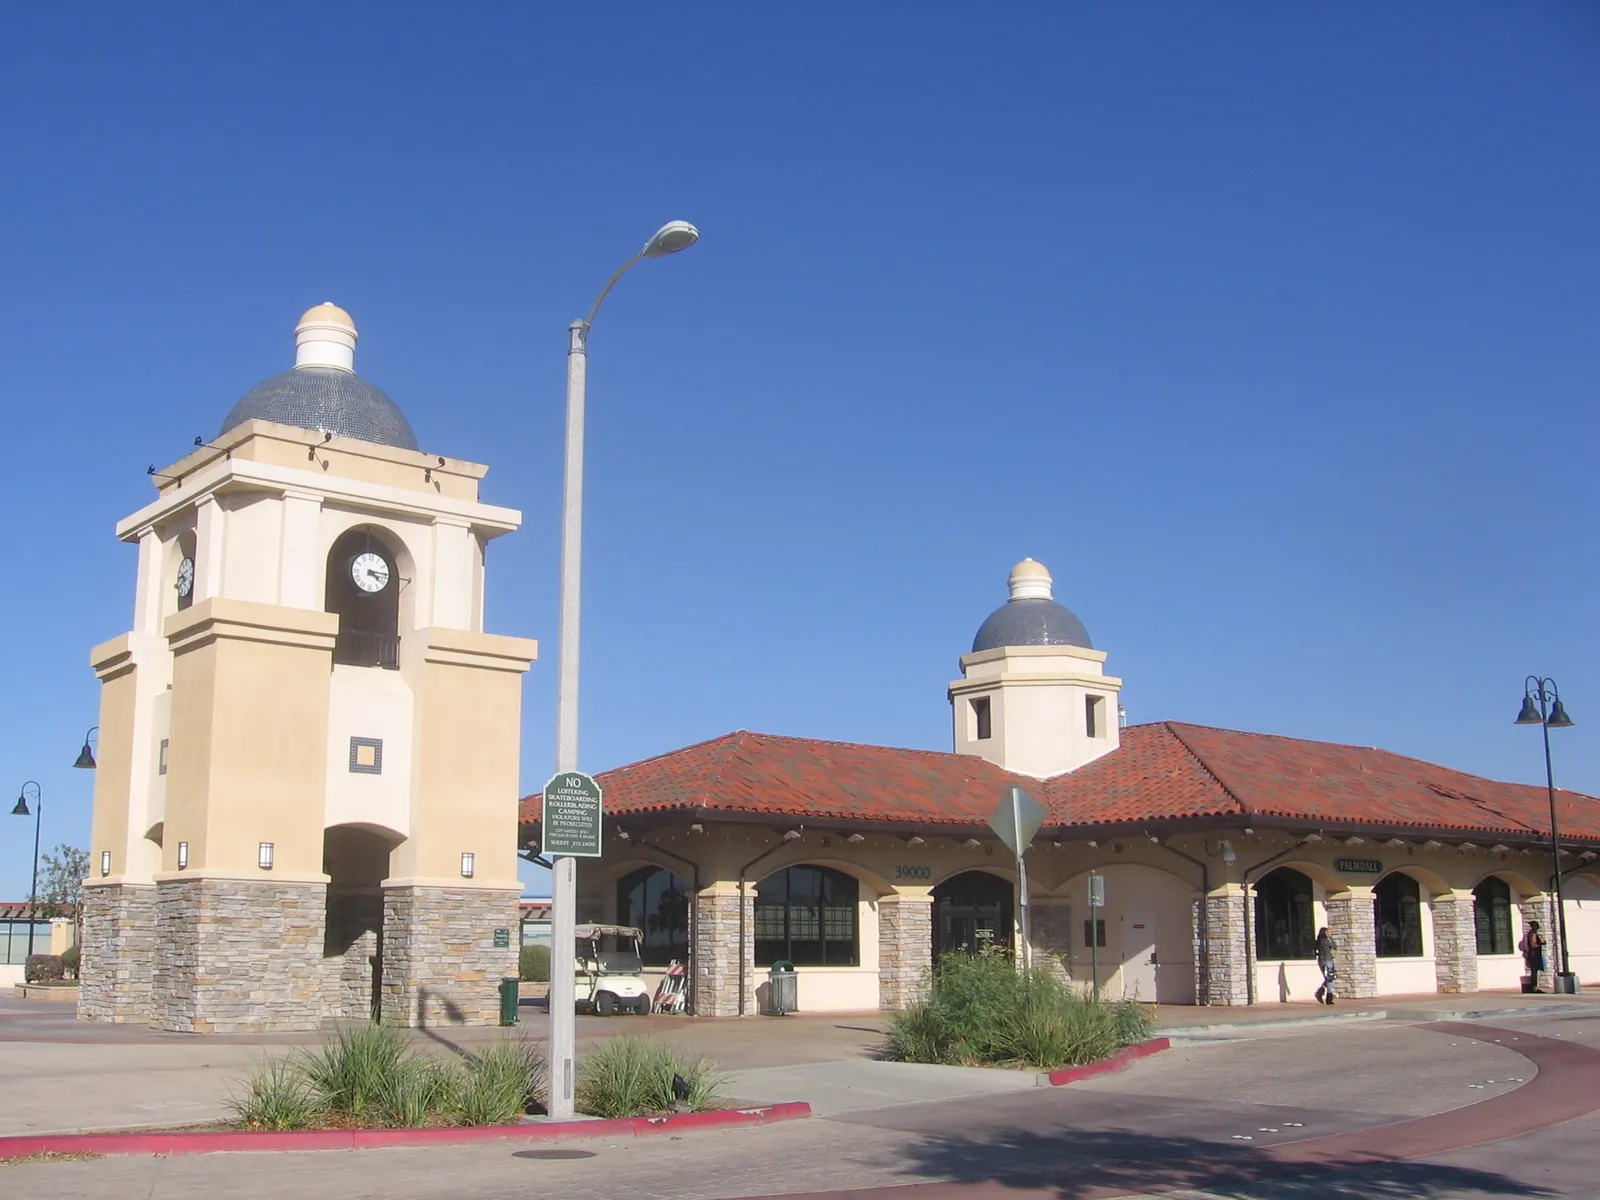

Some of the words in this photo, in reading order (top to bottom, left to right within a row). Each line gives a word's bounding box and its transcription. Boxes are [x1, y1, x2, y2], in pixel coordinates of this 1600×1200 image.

[566, 777, 581, 788] NO
[557, 788, 589, 796] LOITERING
[548, 794, 598, 803] SKATEBOARDING
[548, 801, 597, 810] ROLLERBLADING
[558, 808, 588, 816] CAMPING
[560, 820, 593, 828] PROSECUTED
[1340, 860, 1378, 871] PALMDALE
[895, 866, 931, 879] 39000
